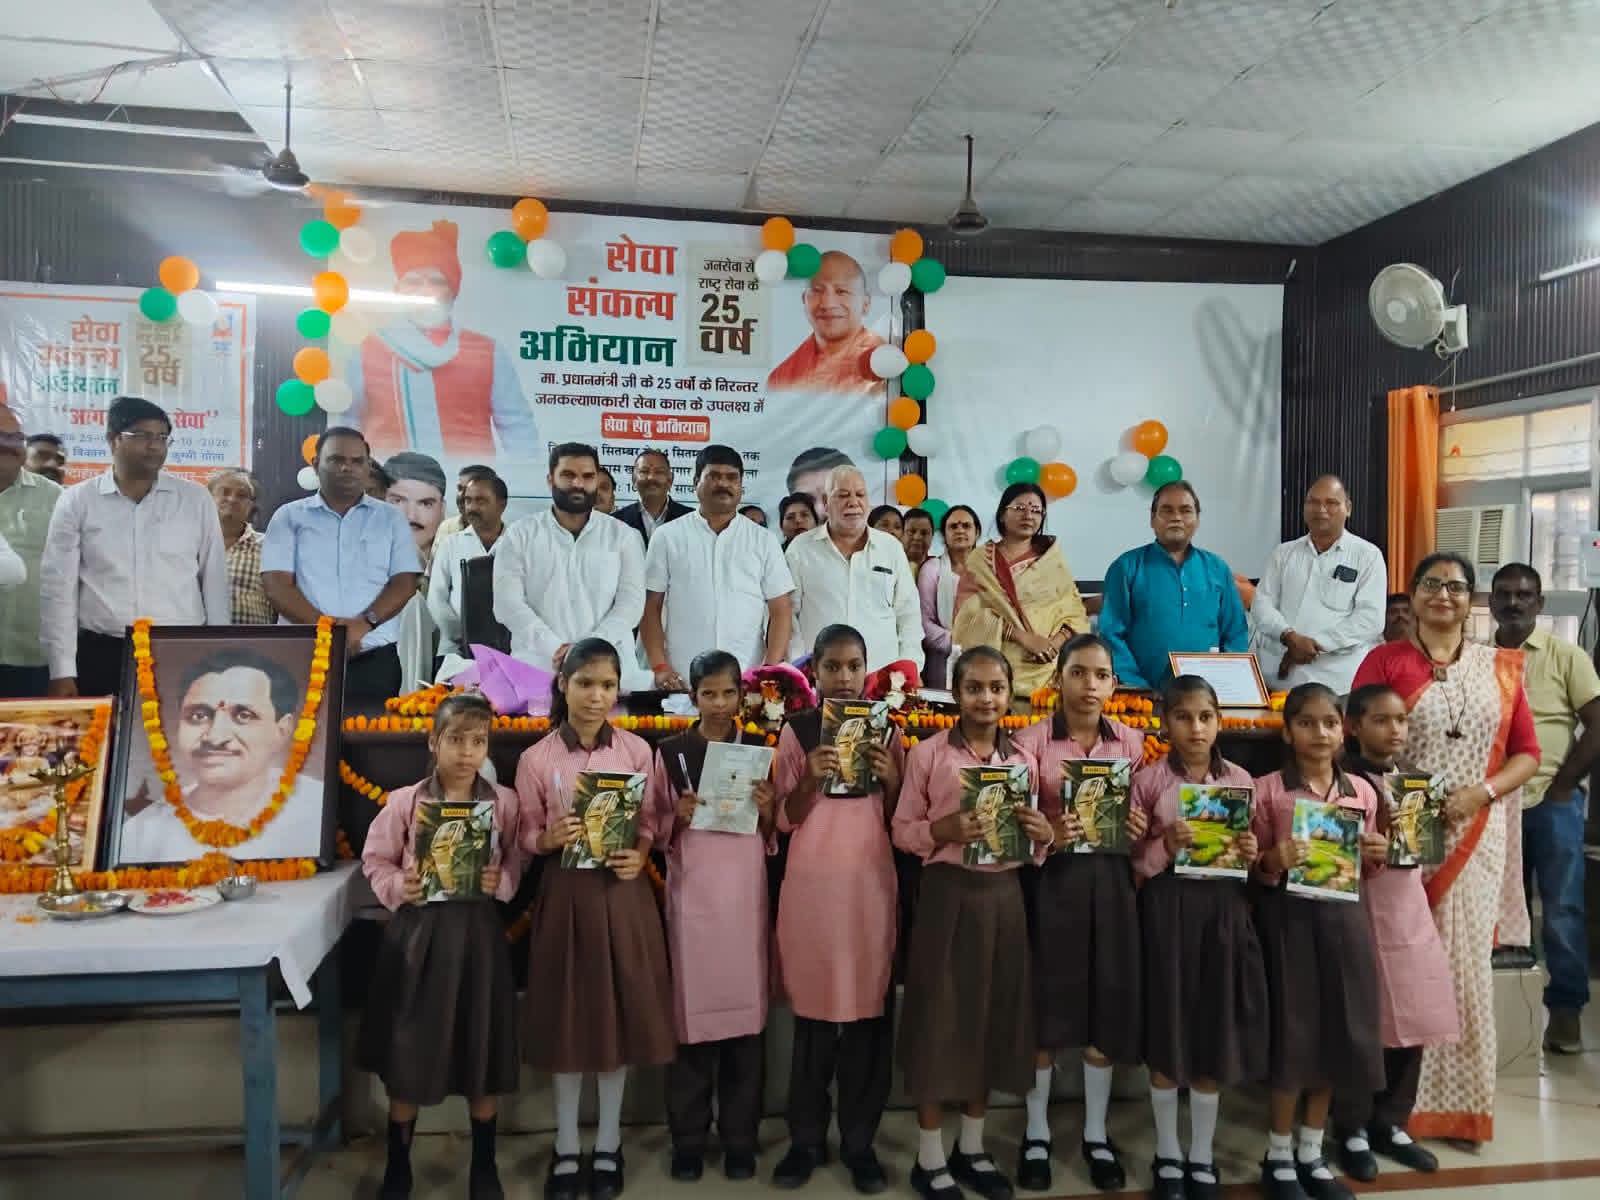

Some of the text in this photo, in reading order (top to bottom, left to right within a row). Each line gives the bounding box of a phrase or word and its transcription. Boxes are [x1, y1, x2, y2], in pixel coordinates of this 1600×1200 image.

[605, 233, 678, 276] सेवा
[703, 258, 742, 273] जनसेवा
[724, 276, 745, 291] सेवा
[747, 276, 760, 291] के
[566, 276, 678, 320] संकल्प
[701, 293, 740, 324] 25
[71, 314, 121, 344] सेवा
[699, 318, 759, 355] वर्ष
[141, 345, 170, 368] 25
[519, 325, 677, 367] अभियान
[540, 373, 559, 385] मा.
[562, 371, 618, 388] प्रधानमंत्री
[621, 373, 637, 389] जी
[640, 375, 654, 389] के
[657, 378, 671, 390] 25
[699, 377, 712, 391] के
[715, 377, 758, 393] निरन्तर
[535, 392, 765, 413] जनकल्याणकारी सेवा काल के उपलक्ष्य में
[604, 416, 628, 432] सेवा
[656, 418, 707, 435] अभियान
[742, 451, 761, 460] तक
